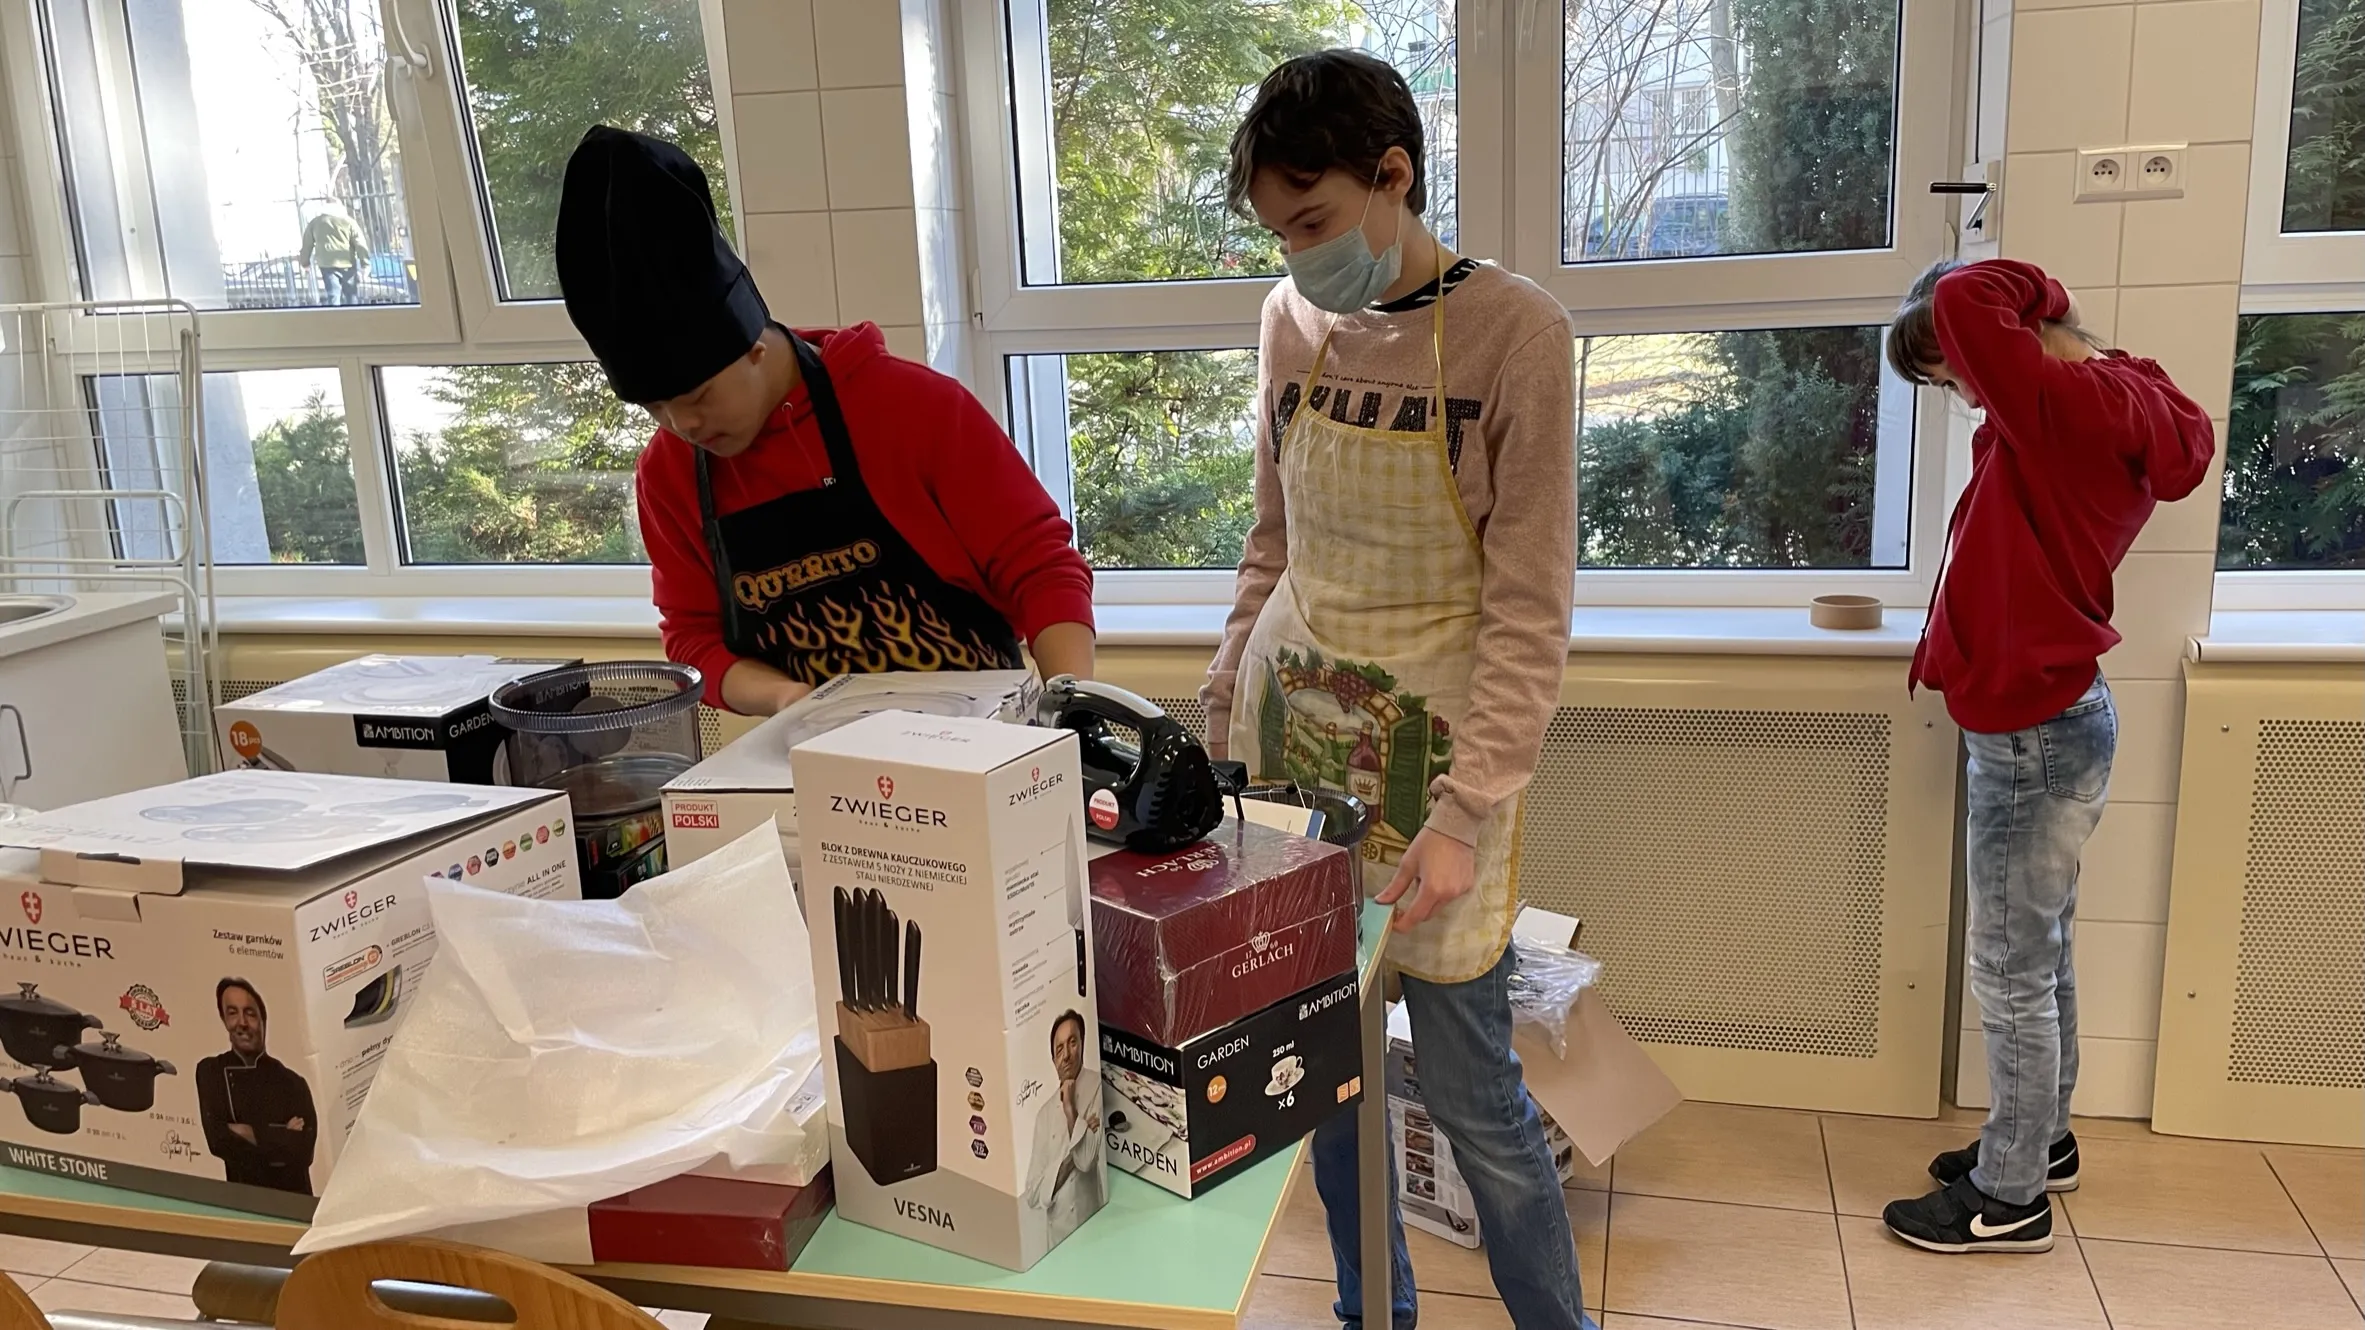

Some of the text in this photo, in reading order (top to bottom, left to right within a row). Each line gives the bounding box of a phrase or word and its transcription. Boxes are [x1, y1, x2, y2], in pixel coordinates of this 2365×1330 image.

[1355, 376, 1376, 384] about
[231, 730, 249, 747] 18
[375, 725, 435, 742] AMBITION
[449, 712, 495, 738] GARDEN
[1009, 773, 1064, 806] ZWIEGER
[674, 814, 718, 827] POLSKI
[675, 802, 714, 812] PRODUKT
[830, 795, 948, 828] ZWIEGER
[527, 859, 567, 885] ALL IN ONE
[821, 841, 967, 873] BLOK Z DREWNA KAUCZUKOWEGO
[823, 853, 828, 863] Z
[829, 854, 875, 870] ZESTAWEM
[907, 866, 913, 877] Z
[915, 867, 968, 886] NIEMIECKIEJ
[855, 870, 934, 892] STALI NIERDZEWNEJ
[309, 894, 397, 943] ZWIEGER
[212, 929, 283, 946] Zestaw garnków
[228, 944, 284, 960] 6 elementów
[1231, 942, 1294, 978] GERLACH
[1308, 981, 1357, 1016] AMBITION
[1113, 1040, 1175, 1076] AMBITION
[1197, 1035, 1250, 1070] GARDEN
[1272, 1039, 1295, 1058] 250 ml
[1208, 1084, 1219, 1098] 12
[8, 1146, 108, 1180] WHITE STONE
[1106, 1133, 1178, 1177] GARDEN
[1196, 1140, 1252, 1176] www.ambition.pl
[893, 1197, 956, 1232] VESNA
